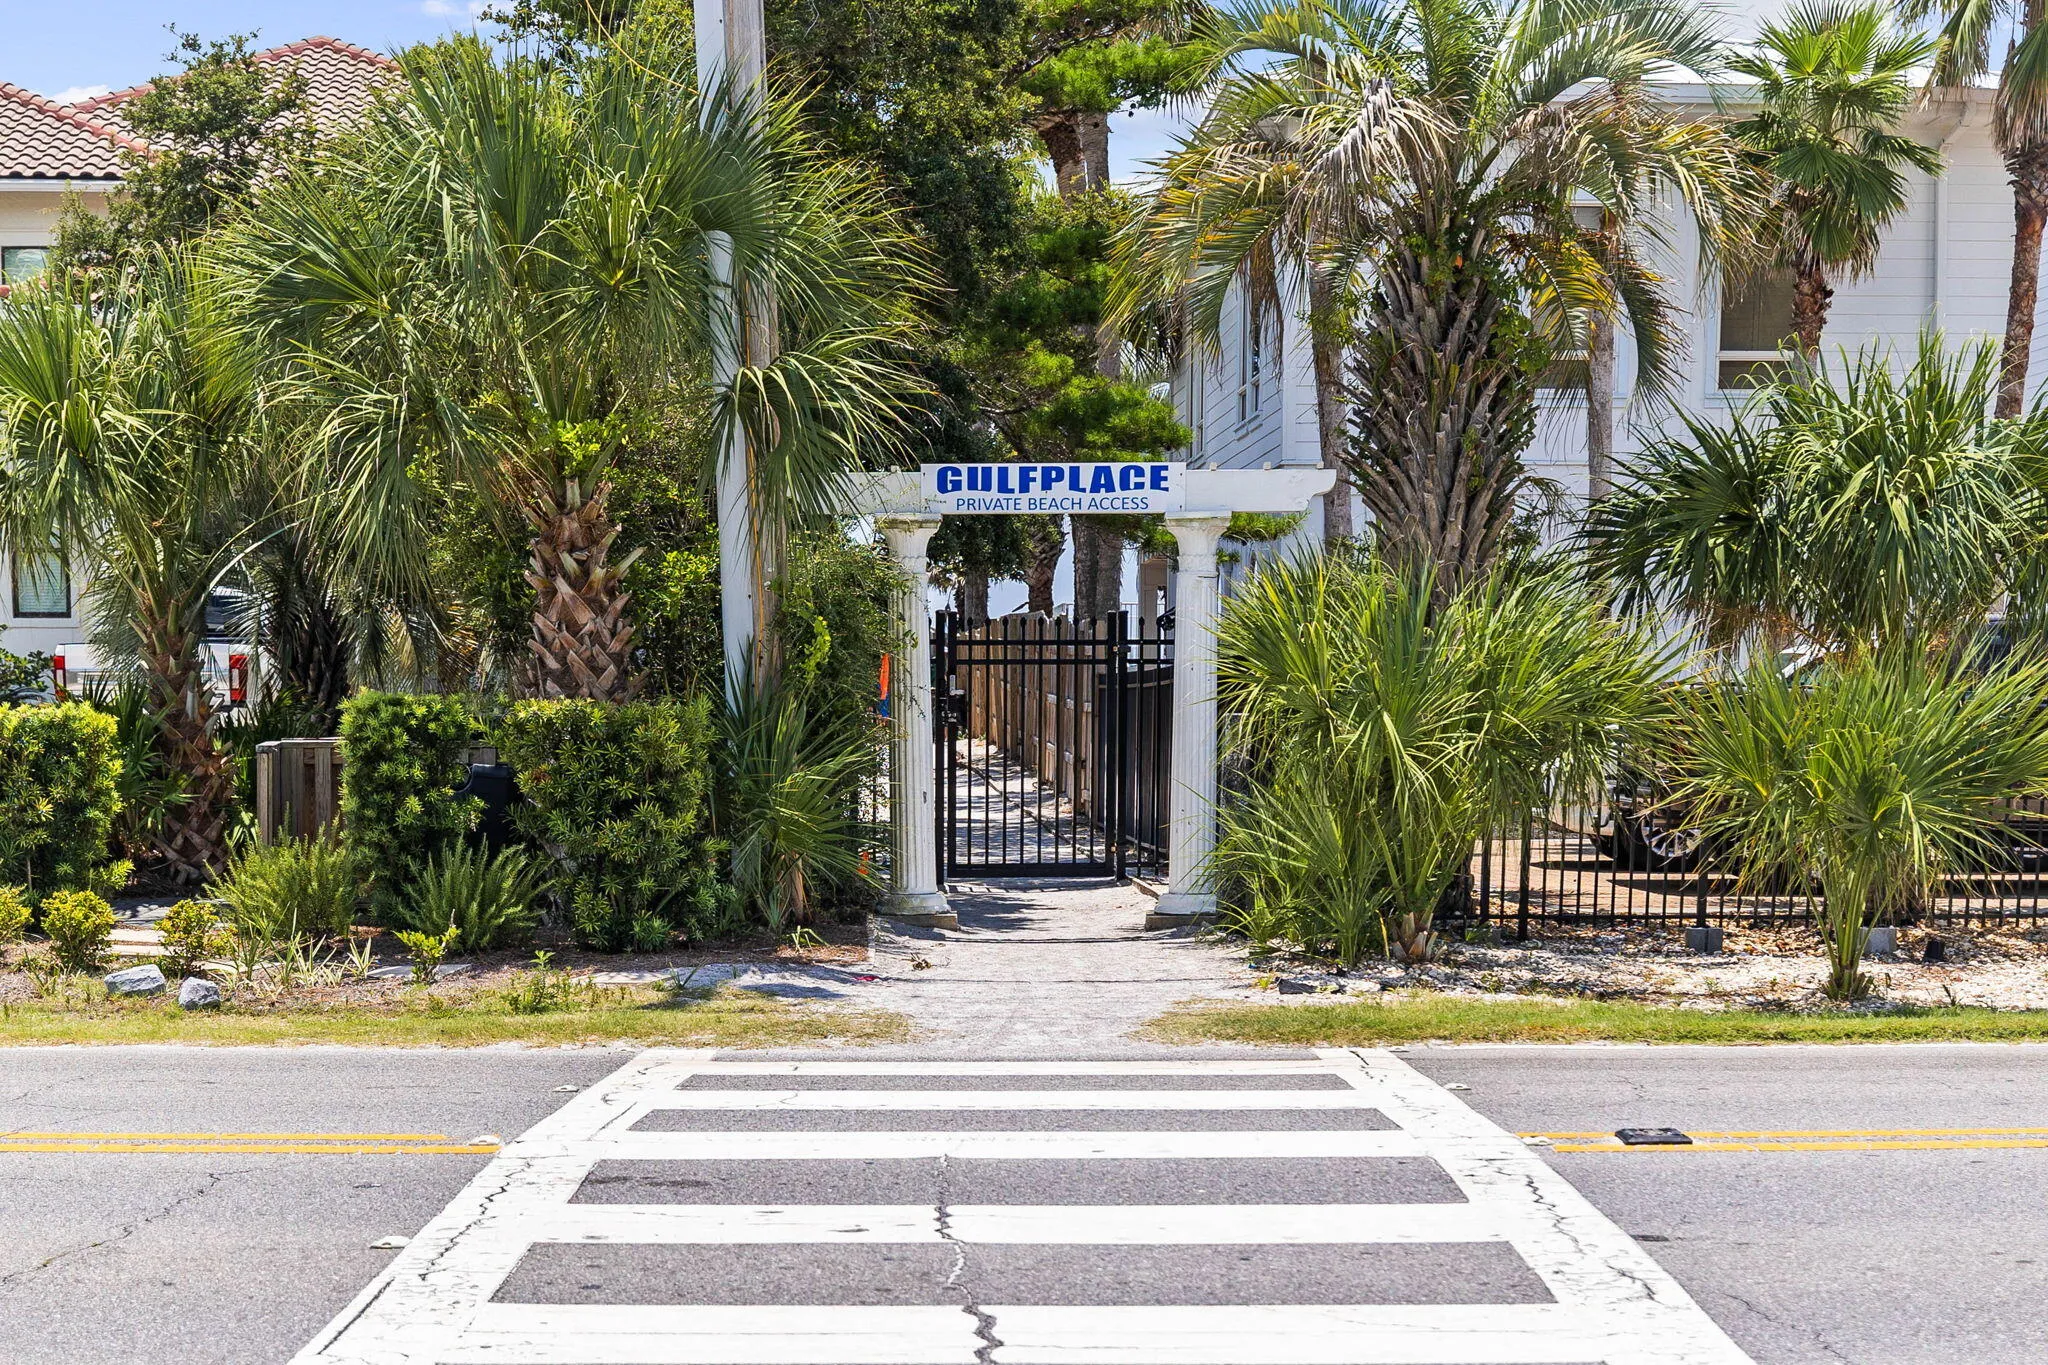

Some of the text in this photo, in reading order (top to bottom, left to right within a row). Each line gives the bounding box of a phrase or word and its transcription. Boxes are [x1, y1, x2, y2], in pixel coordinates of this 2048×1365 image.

[936, 464, 1169, 494] GULFPLACE
[956, 496, 1149, 511] PRIVATE BEACH ACCESS
